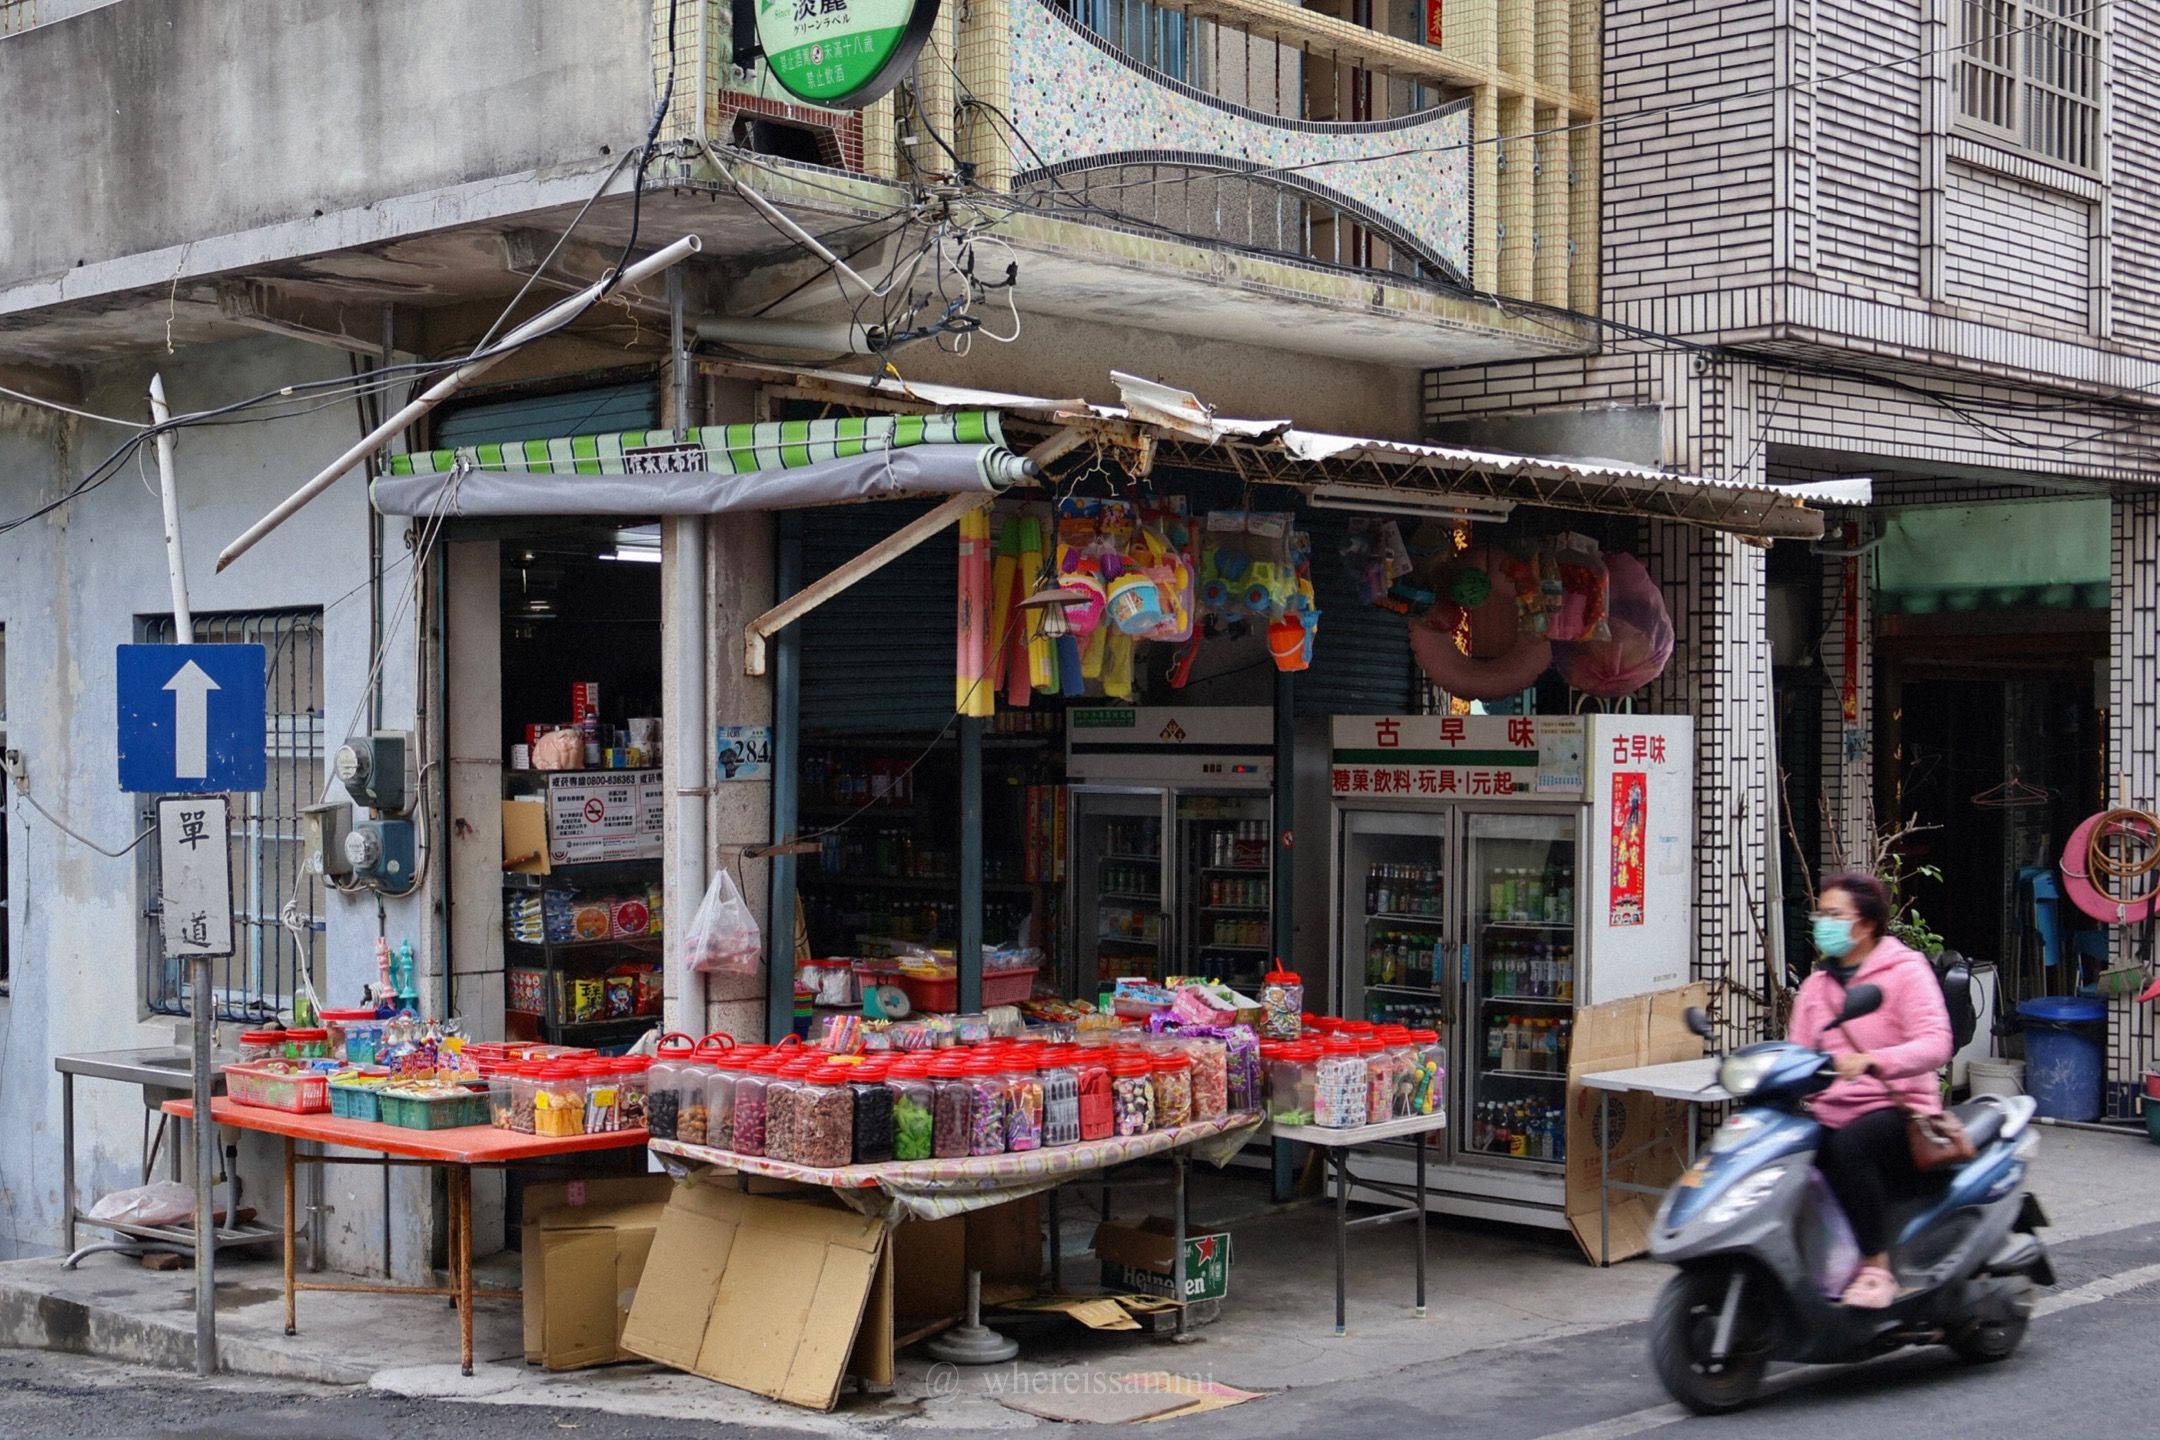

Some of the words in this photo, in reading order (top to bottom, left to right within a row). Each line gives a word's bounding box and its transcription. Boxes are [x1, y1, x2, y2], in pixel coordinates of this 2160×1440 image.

[794, 14, 851, 35] グリーンラベル
[806, 64, 845, 88] 禁止飲酒
[1375, 717, 1535, 748] 古早味
[734, 740, 769, 763] 284
[1612, 734, 1666, 764] 古早味
[178, 810, 213, 948] 單道
